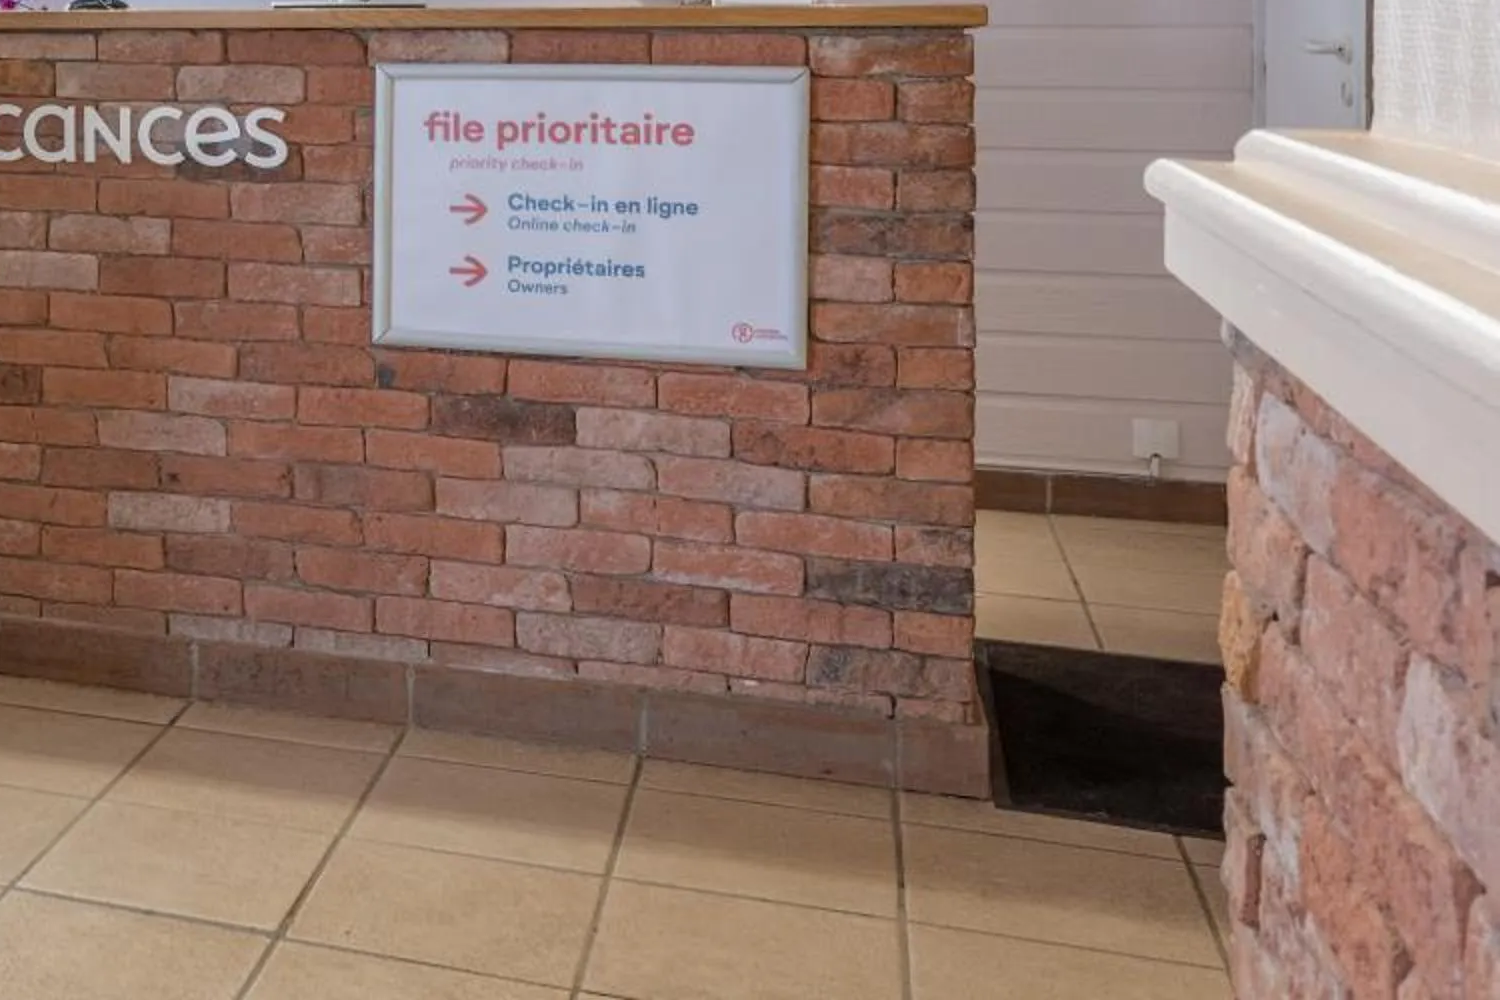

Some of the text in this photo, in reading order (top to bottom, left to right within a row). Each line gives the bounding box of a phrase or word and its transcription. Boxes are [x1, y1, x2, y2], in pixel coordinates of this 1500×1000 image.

[423, 110, 695, 151] file prioritaire
[448, 155, 584, 172] priority check-in
[507, 193, 700, 220] Check-in en ligne
[507, 215, 637, 234] Online check-in
[507, 255, 646, 279] Propriétaires
[507, 279, 568, 295] Owners
